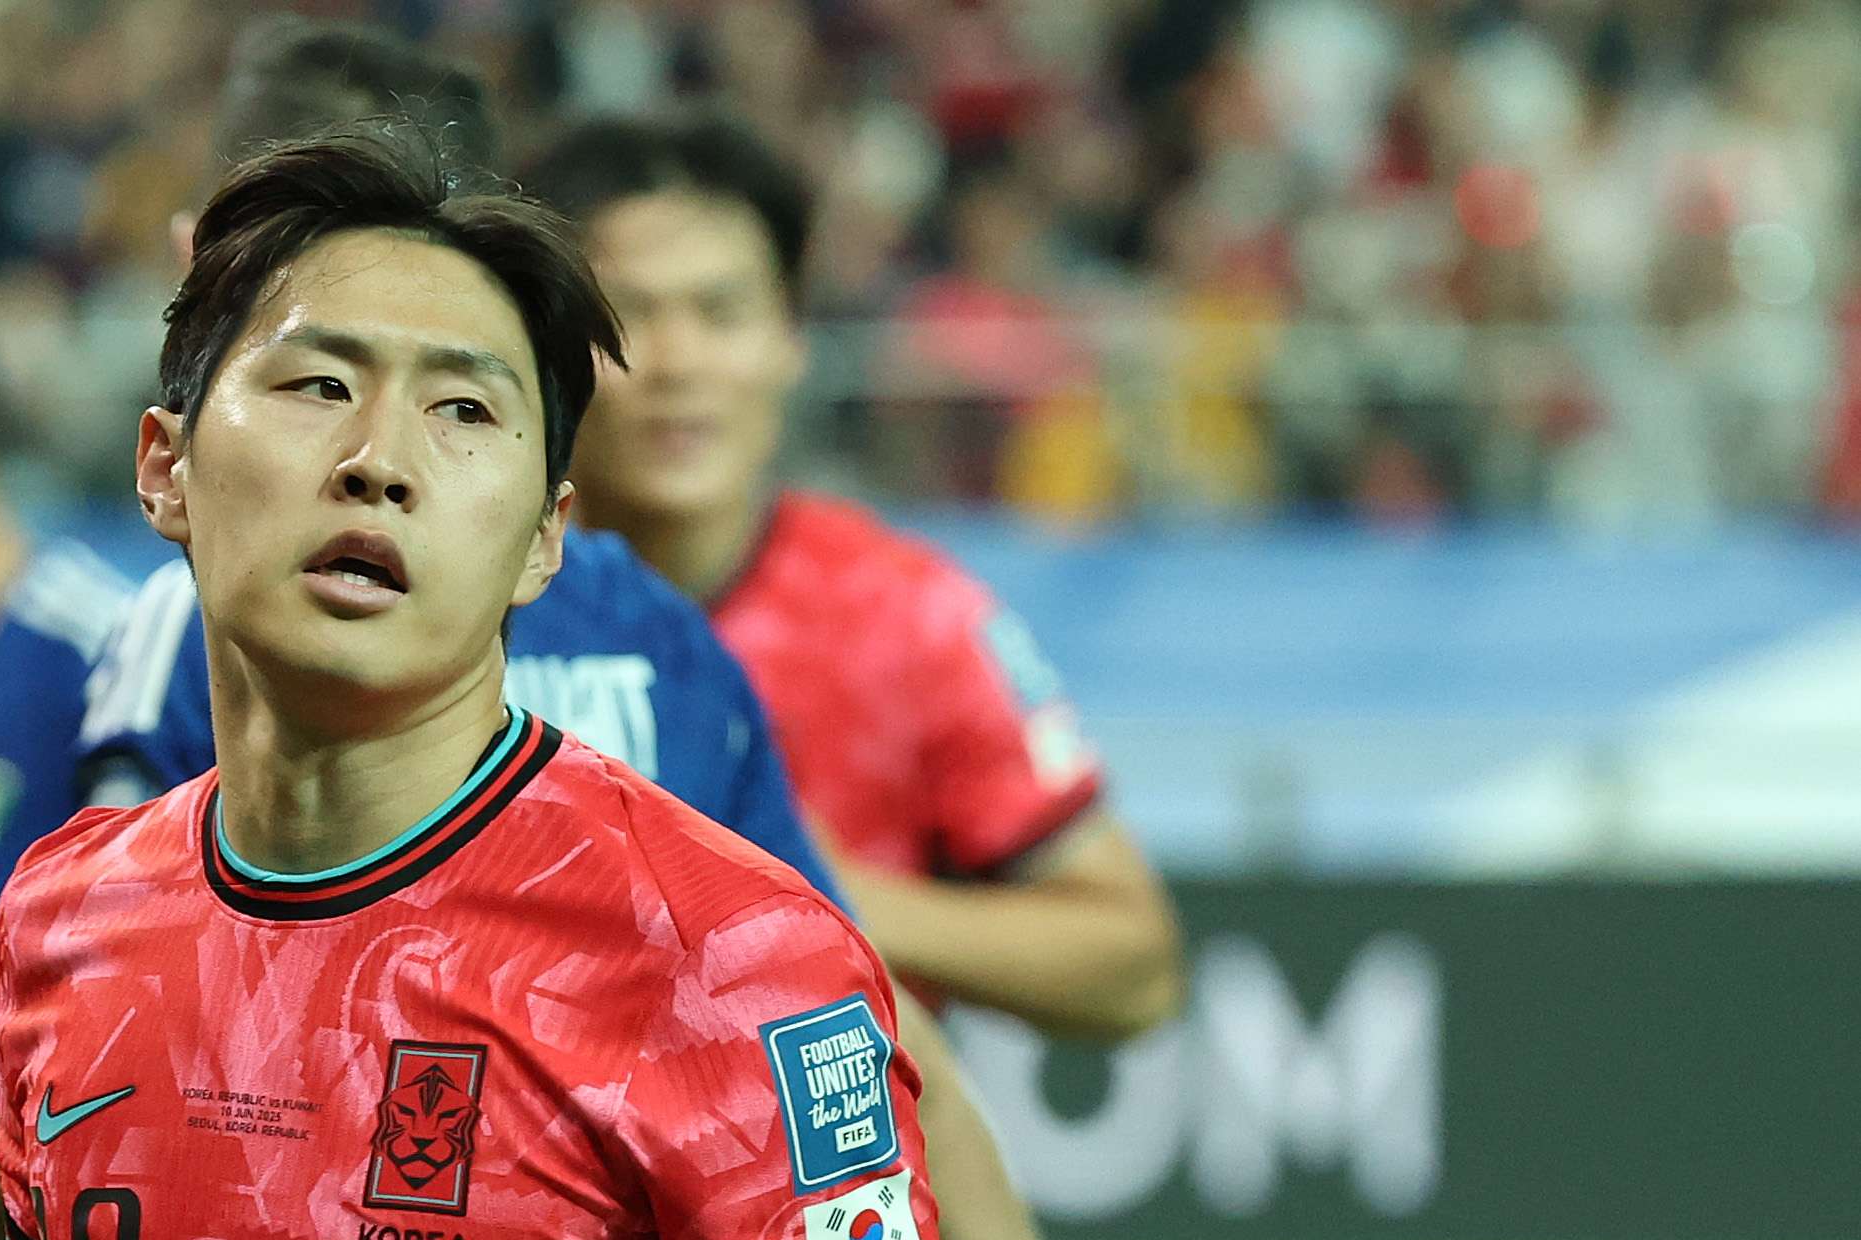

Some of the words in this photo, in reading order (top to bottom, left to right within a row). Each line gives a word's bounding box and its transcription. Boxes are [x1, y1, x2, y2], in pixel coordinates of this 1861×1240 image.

[799, 1025, 874, 1068] FOOTBALL
[805, 1049, 876, 1100] UNITES
[183, 1087, 213, 1100] KOREA
[218, 1091, 265, 1106] REPUBLIC
[807, 1100, 842, 1129] the
[841, 1078, 882, 1120] World
[221, 1105, 232, 1117] 10
[234, 1107, 254, 1119] JUN
[257, 1109, 282, 1122] 2025
[225, 1120, 257, 1134] KOREA
[261, 1124, 310, 1140] REPUBLIC
[842, 1124, 871, 1145] FIFA
